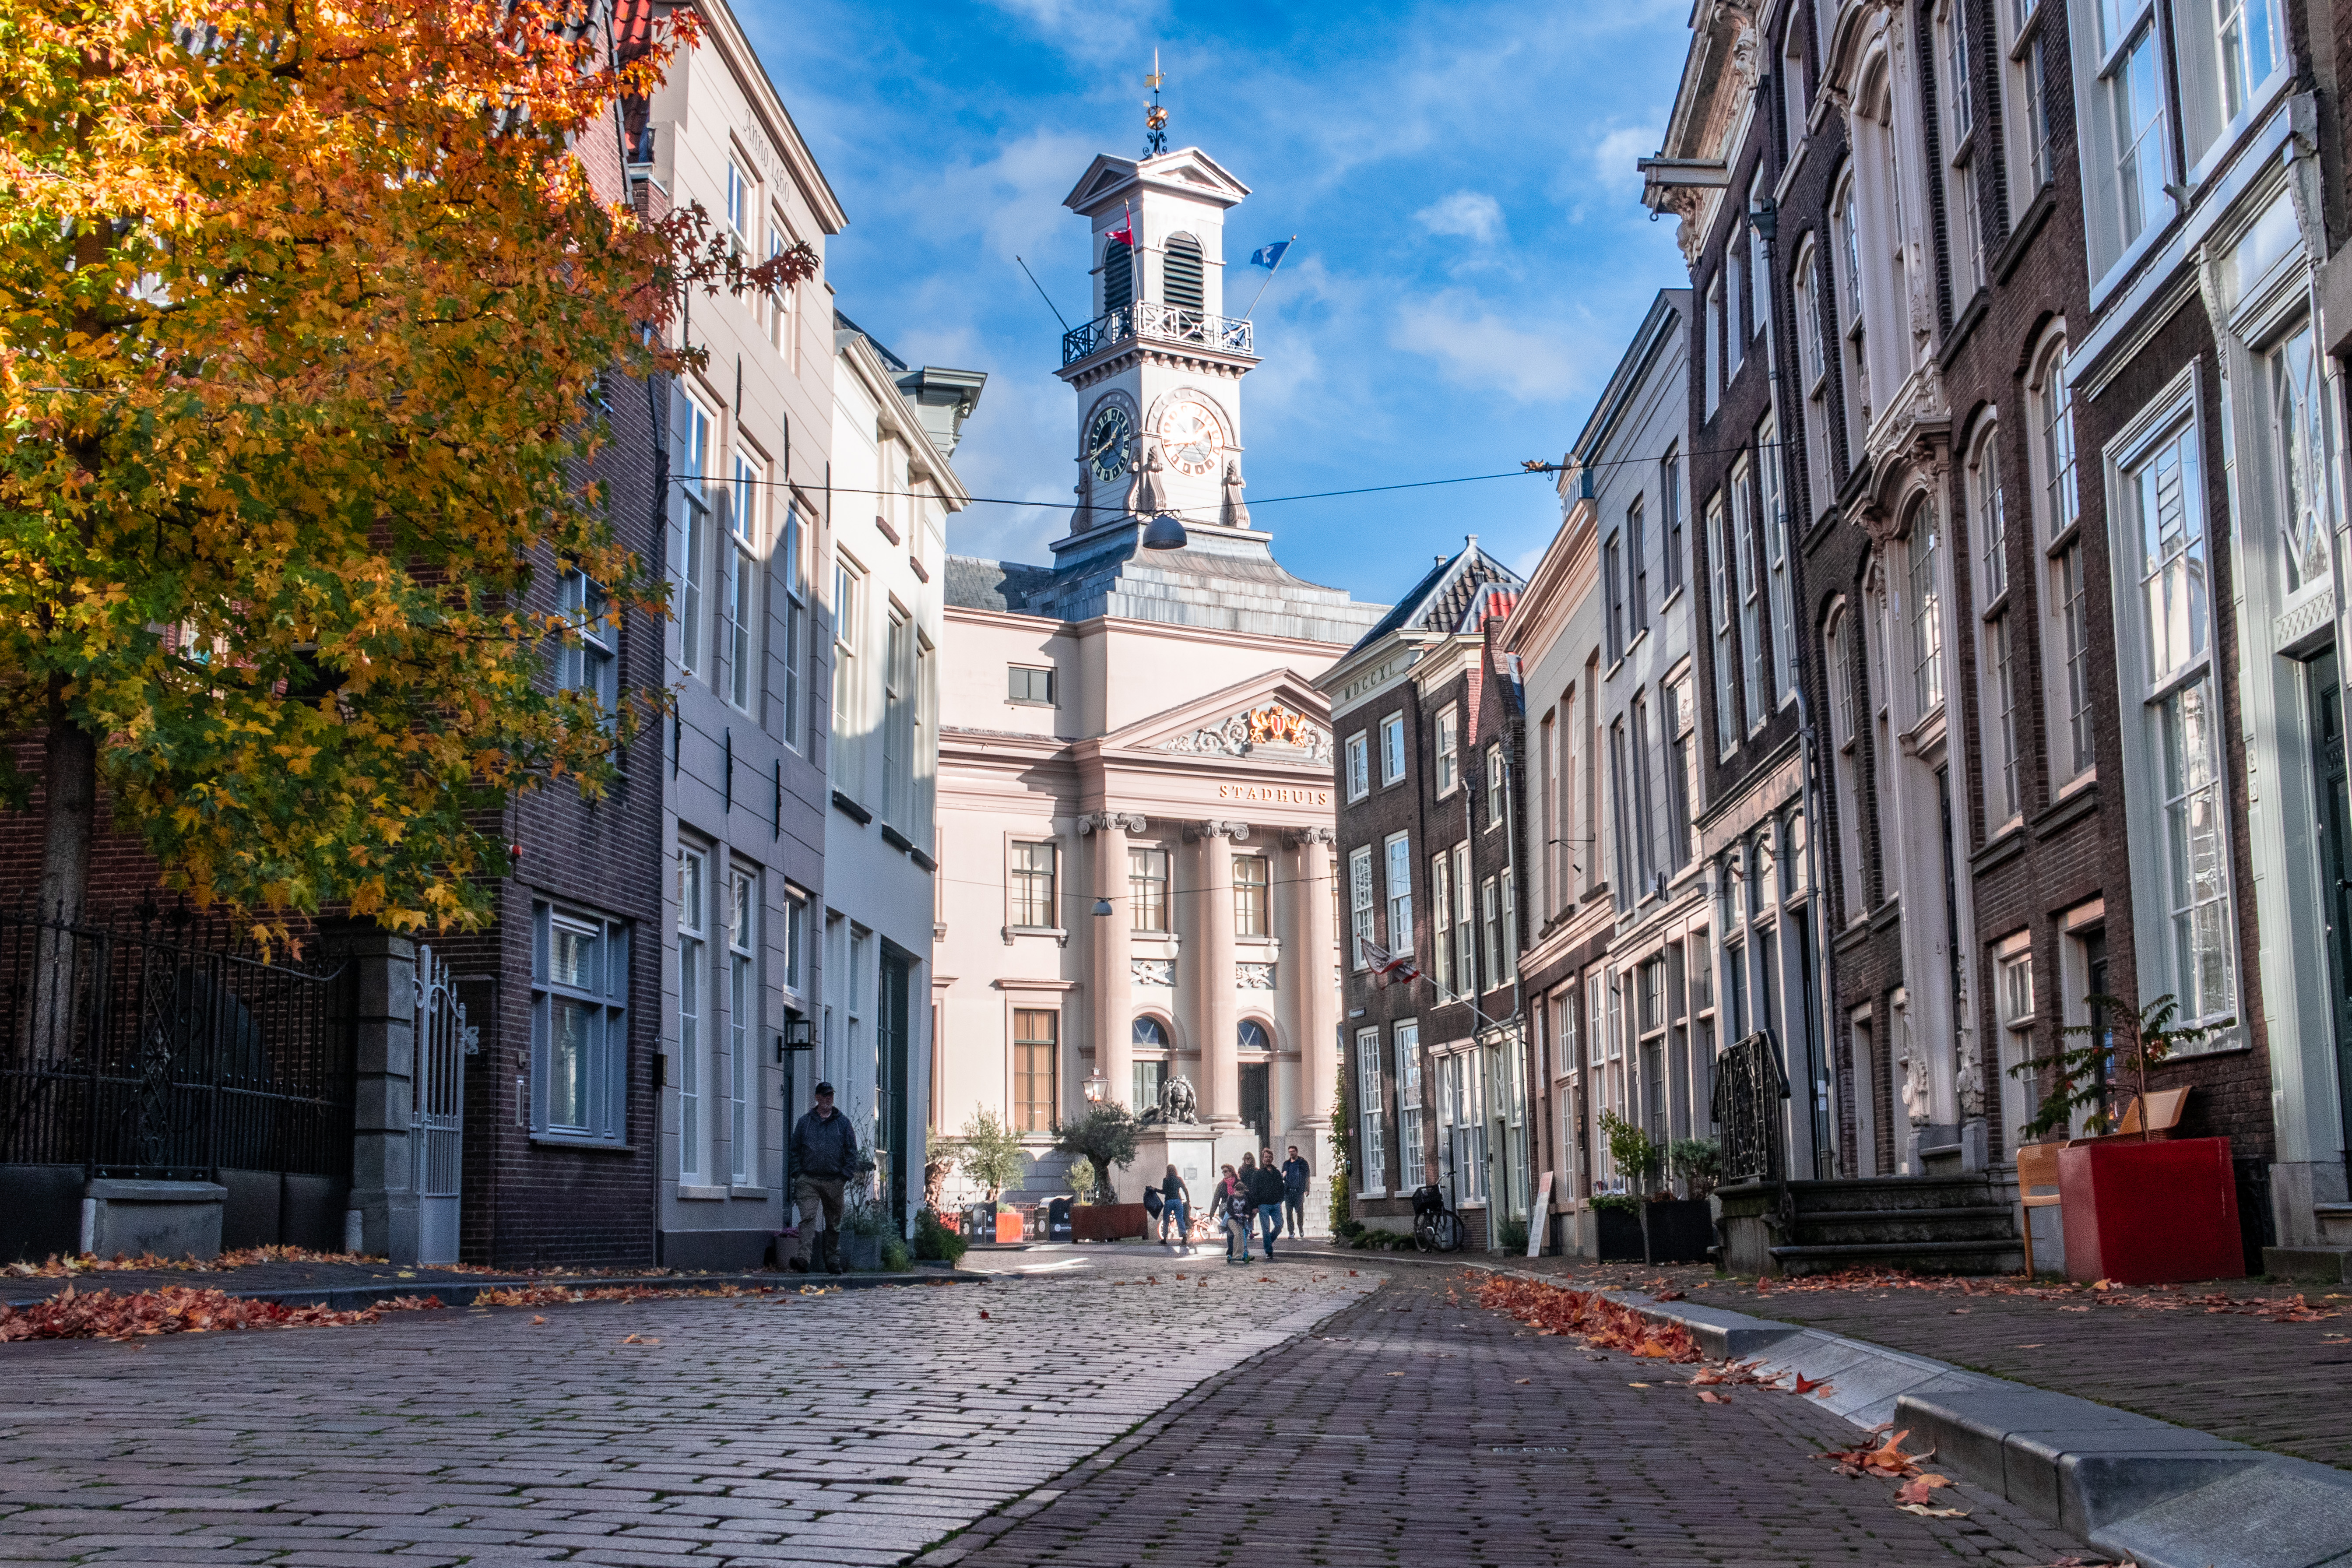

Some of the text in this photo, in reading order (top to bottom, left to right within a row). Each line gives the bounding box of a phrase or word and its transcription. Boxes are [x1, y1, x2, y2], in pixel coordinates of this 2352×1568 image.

[743, 109, 789, 202] Anno 1460
[1345, 661, 1395, 700] MDCCXL
[2248, 753, 2254, 768] 18
[1220, 784, 1327, 805] STADHUIS
[2250, 782, 2256, 798] 20
